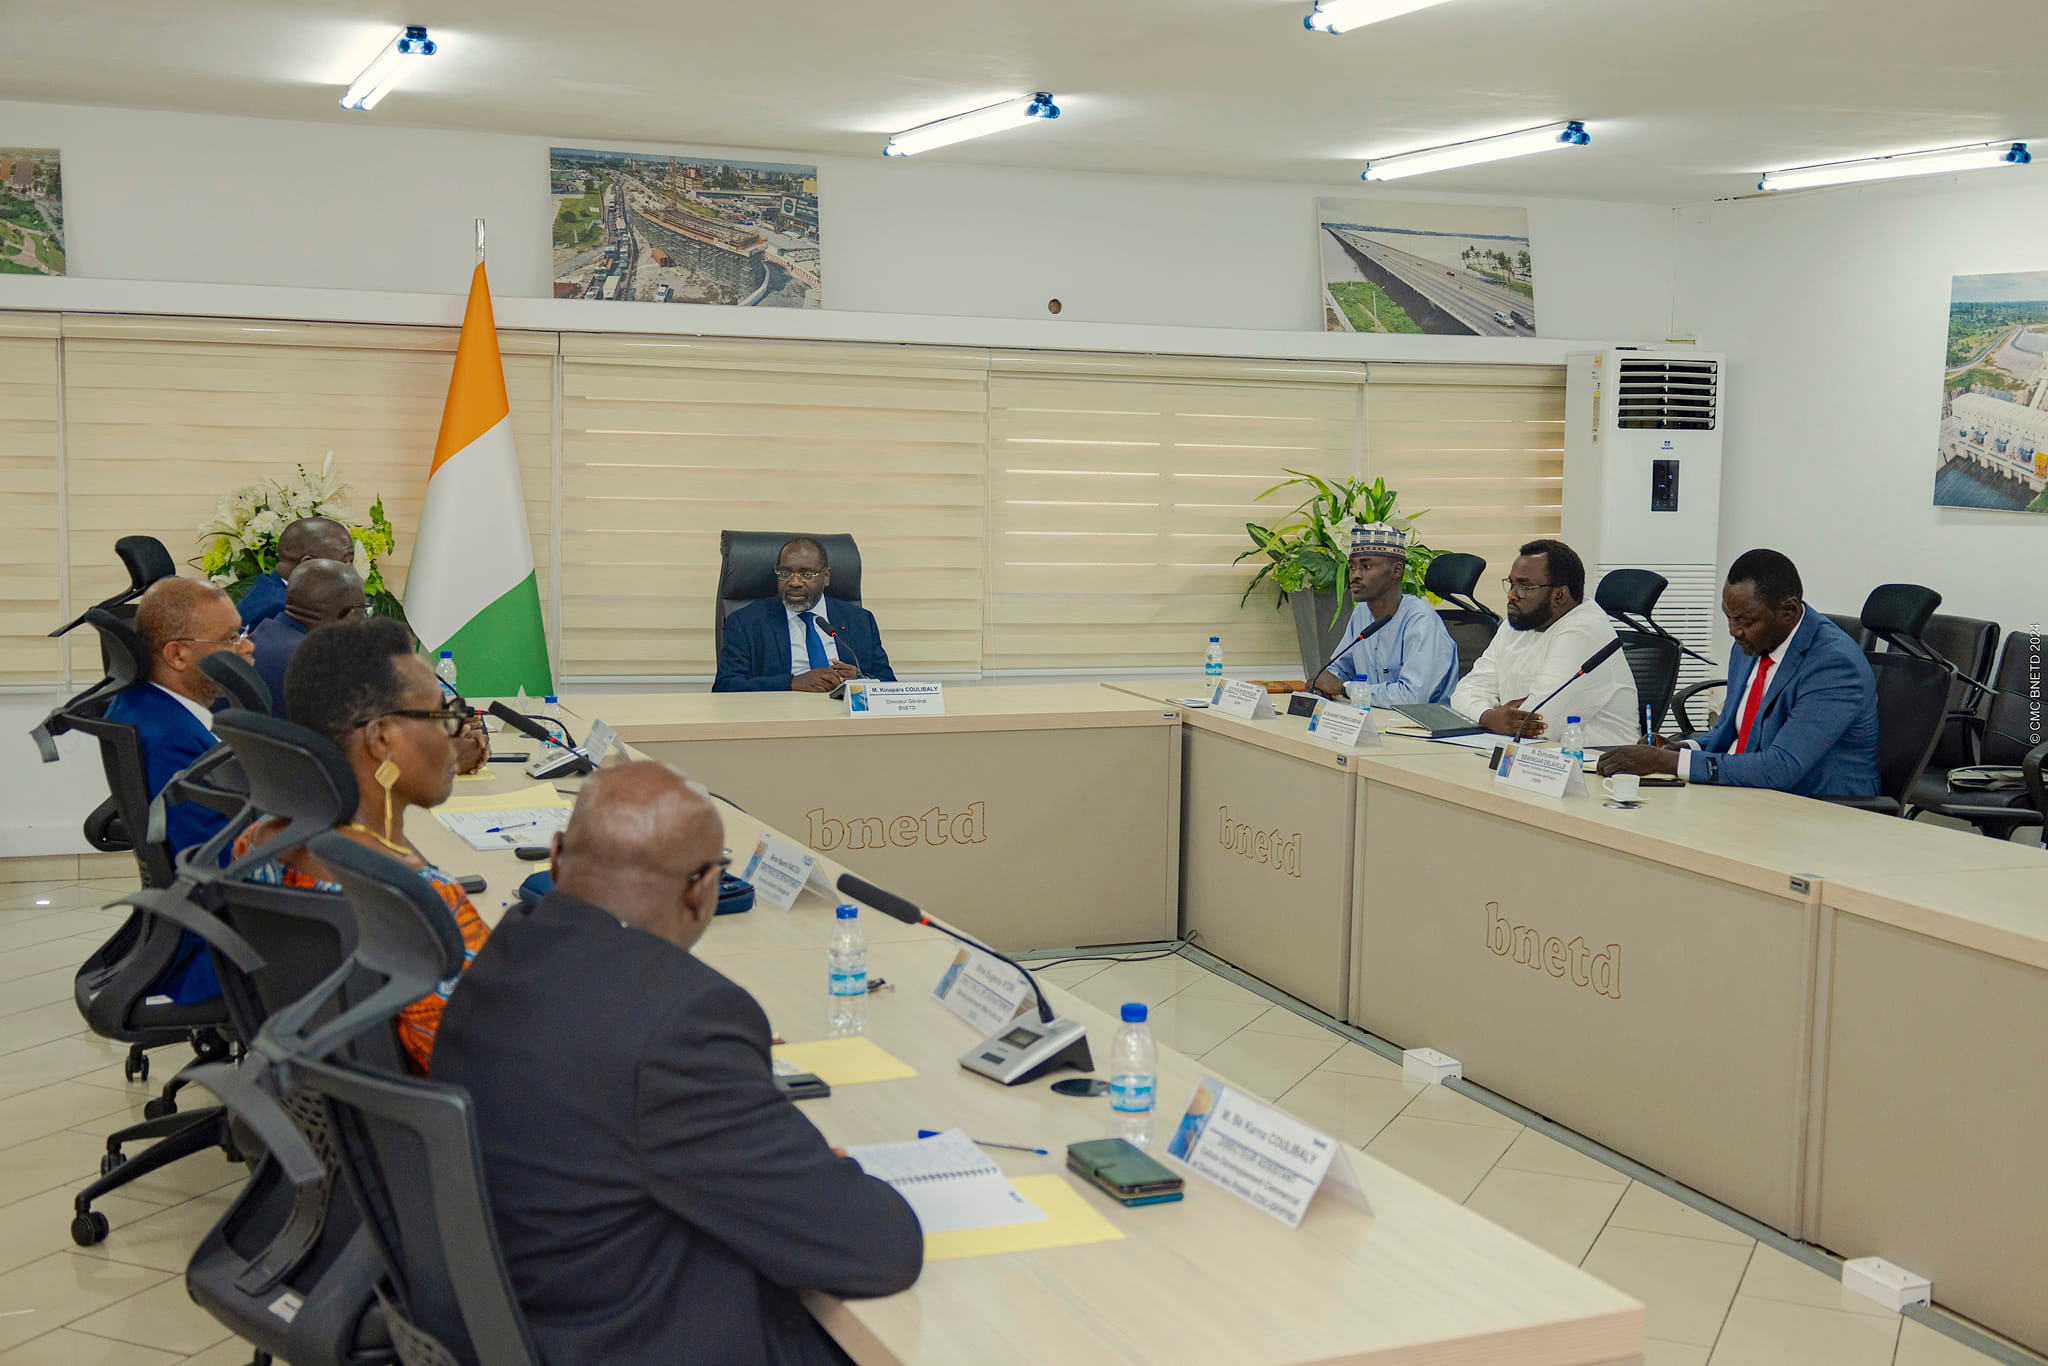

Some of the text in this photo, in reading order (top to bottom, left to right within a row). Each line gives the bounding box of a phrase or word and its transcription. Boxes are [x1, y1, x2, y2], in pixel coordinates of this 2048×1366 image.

[806, 801, 987, 851] bnetd
[1219, 806, 1301, 878] bnetd
[1485, 901, 1621, 999] bnetd
[1267, 1134, 1317, 1165] COULIBALY
